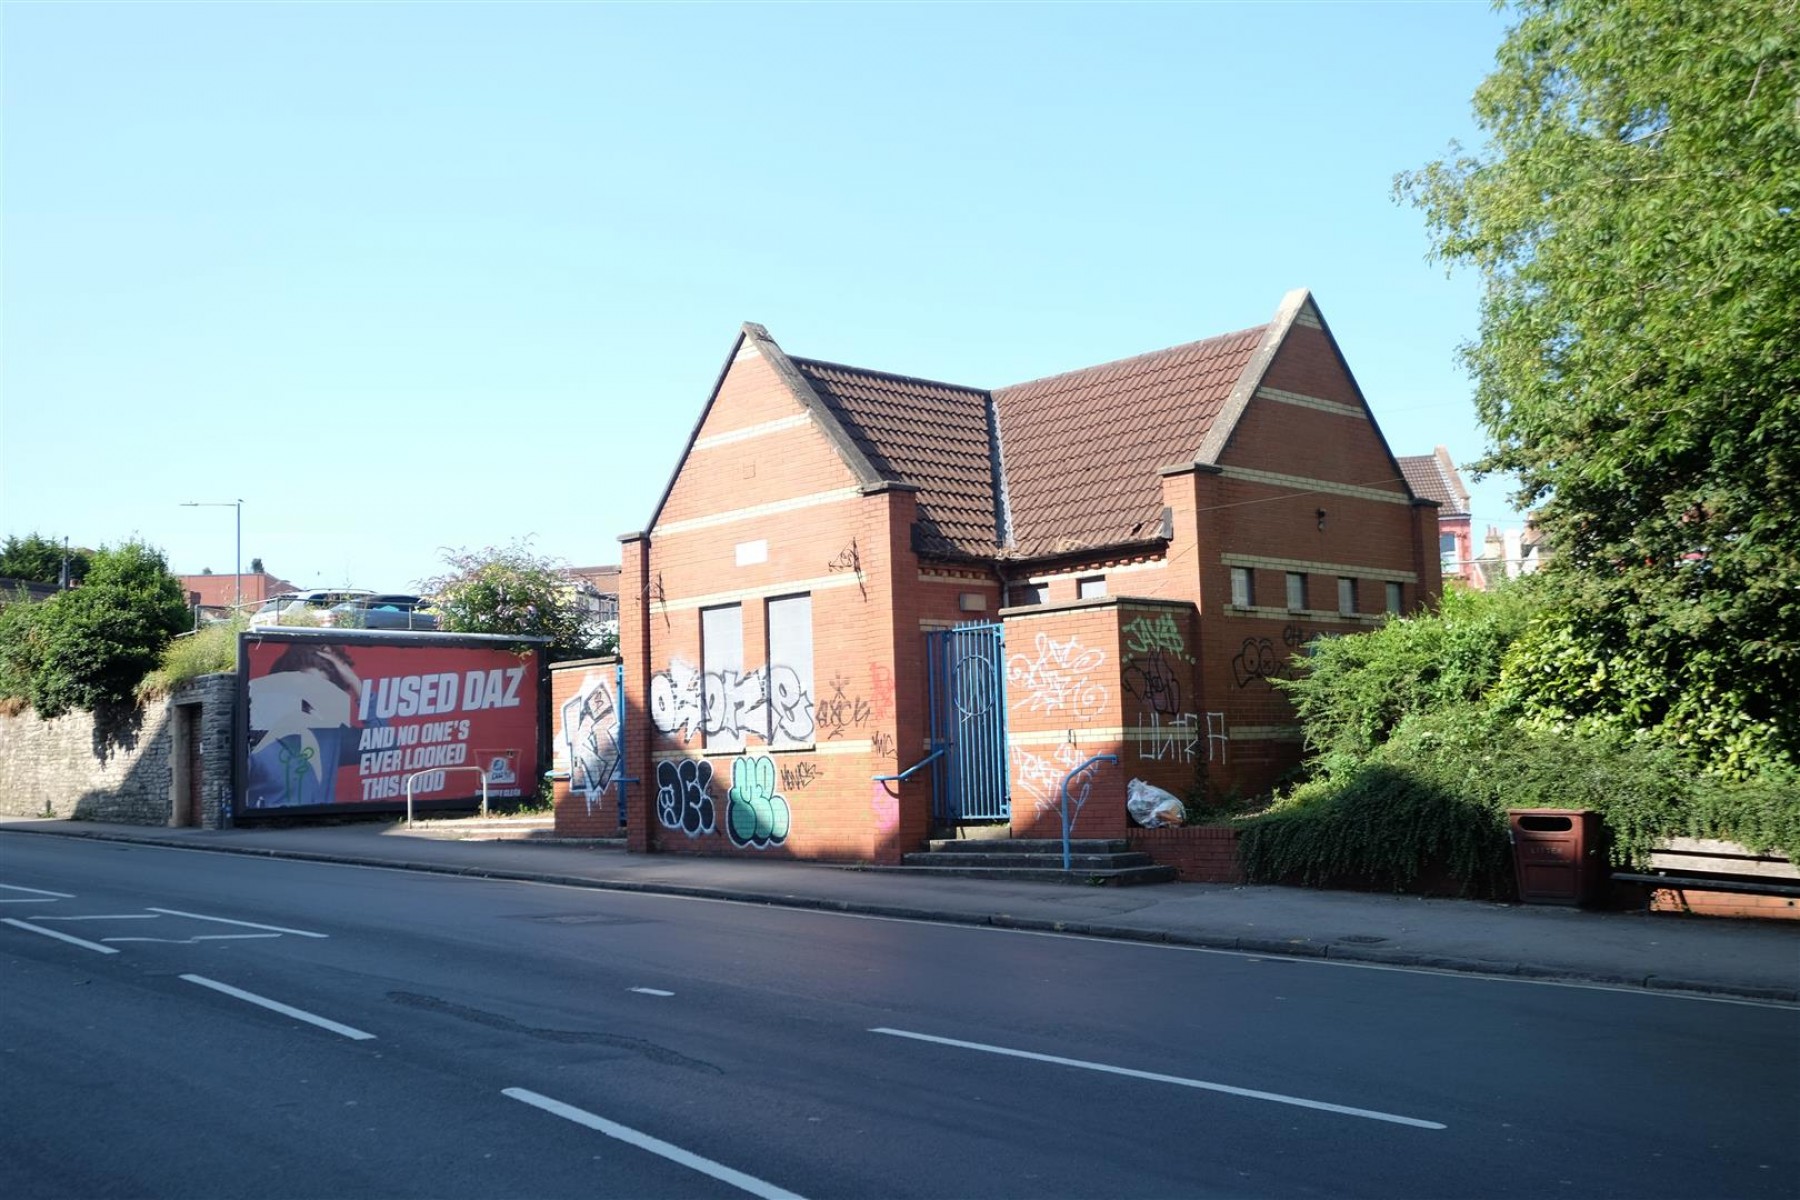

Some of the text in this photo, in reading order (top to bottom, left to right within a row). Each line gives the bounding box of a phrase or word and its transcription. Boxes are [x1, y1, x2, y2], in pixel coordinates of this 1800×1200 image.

[358, 667, 524, 720] I USED DAZ
[358, 719, 470, 750] AND NO ONE'S
[359, 743, 467, 775] EVER LOOKED
[361, 770, 446, 800] THIS GOOD
